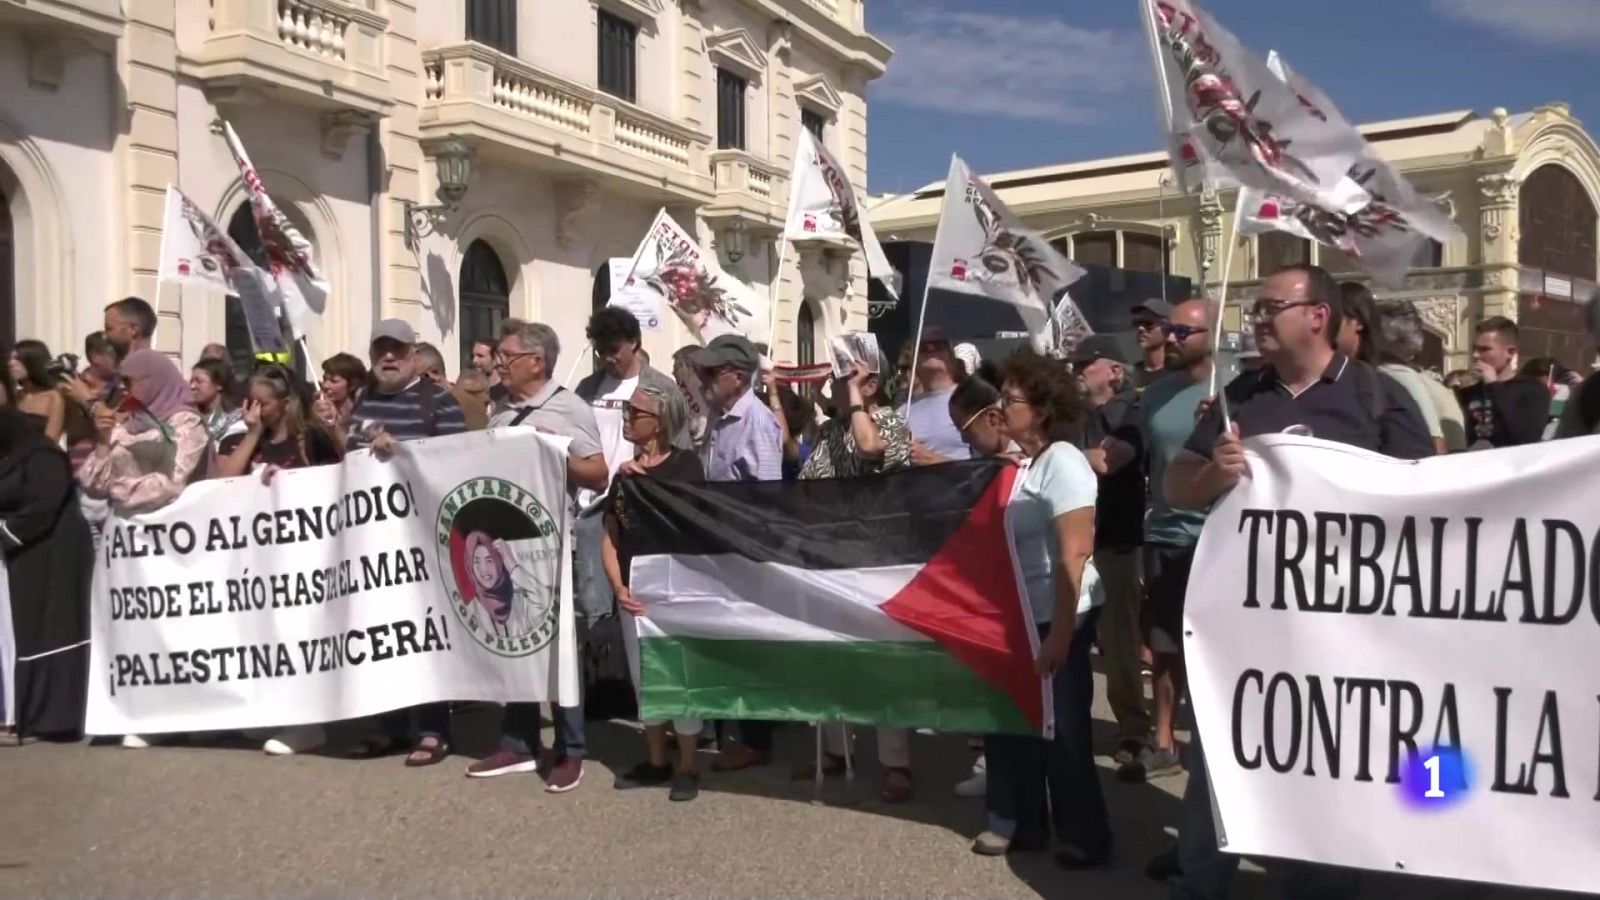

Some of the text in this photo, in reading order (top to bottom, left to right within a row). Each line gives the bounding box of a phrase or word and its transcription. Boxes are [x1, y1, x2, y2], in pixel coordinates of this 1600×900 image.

[660, 221, 700, 260] STOP
[105, 481, 419, 569] ¡ALTO AL GENOCIDIO!
[439, 480, 554, 546] SANITARI@S
[110, 547, 430, 620] DESDE EL RÍO HASTA EL MAR
[1238, 508, 1600, 626] TREBALLAD
[109, 606, 451, 696] ¡PALESTINA VENCERÁ!
[452, 590, 478, 632] CON
[1231, 668, 1468, 791] CONTRA
[1490, 686, 1570, 799] LA
